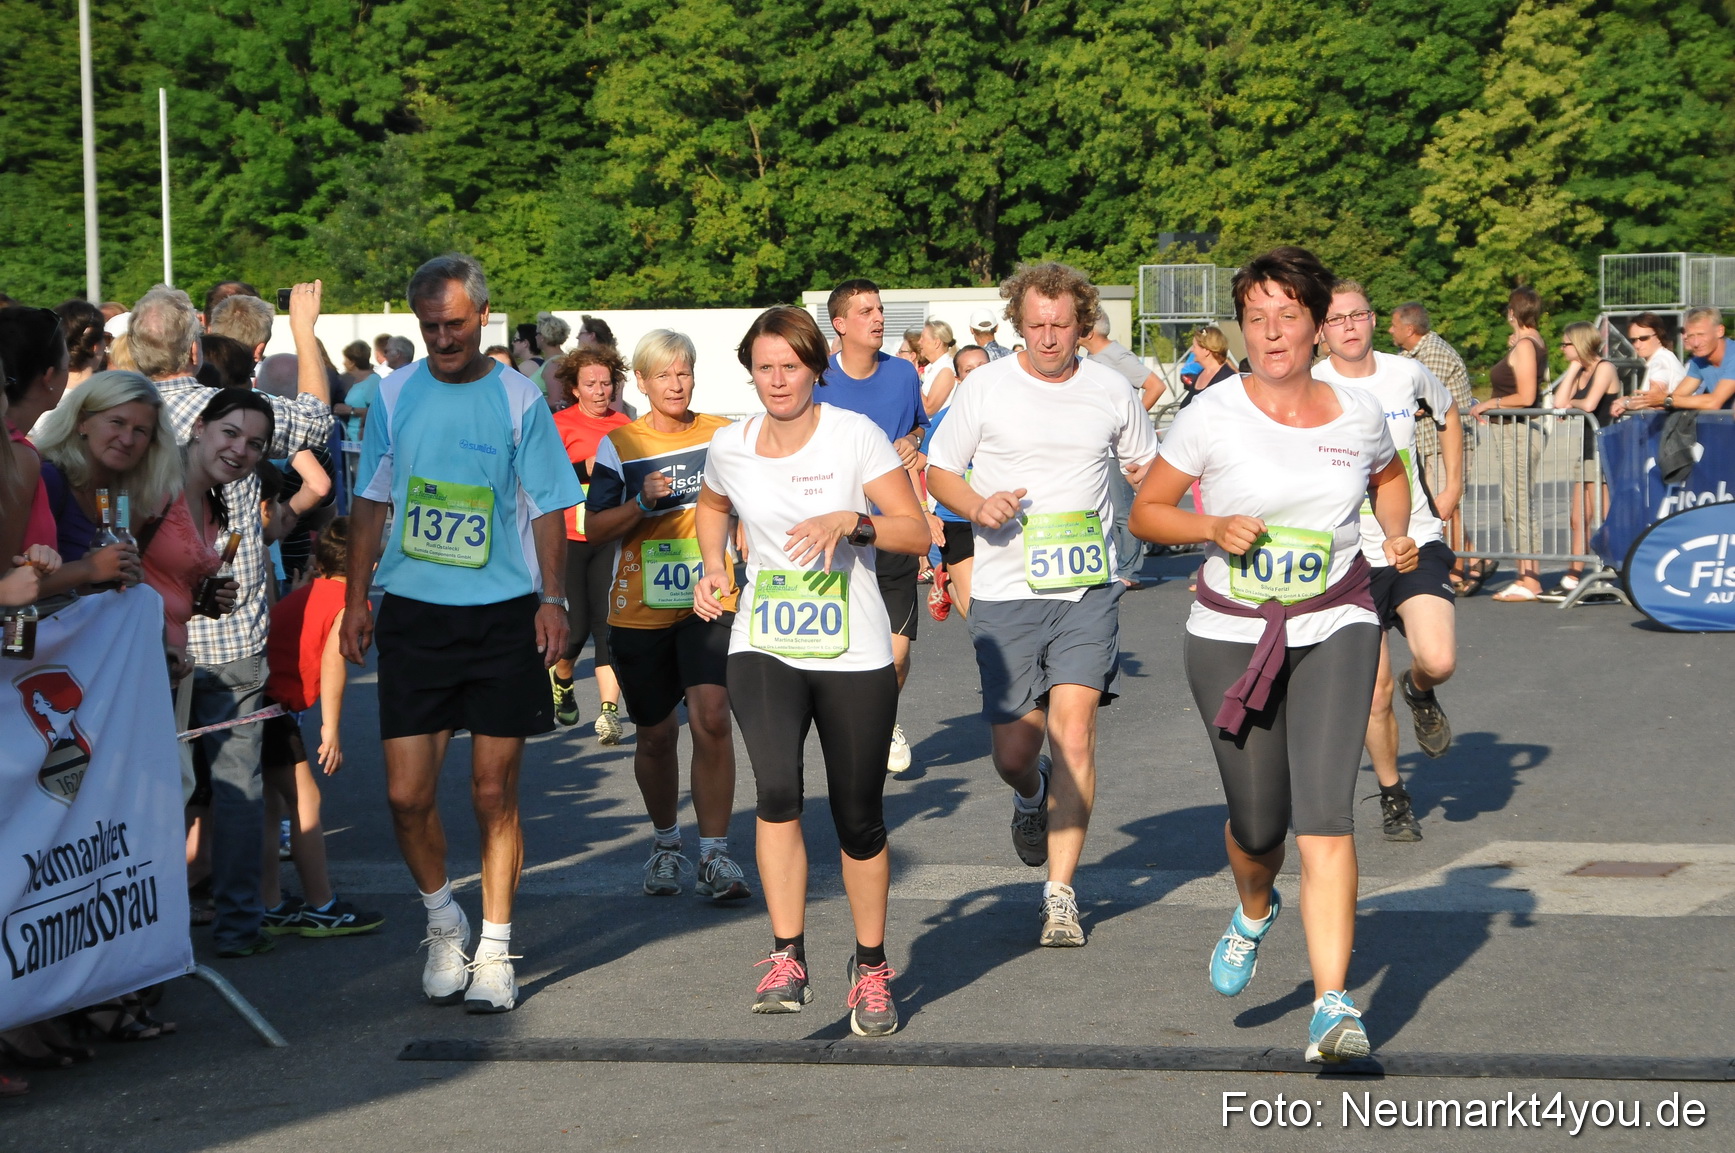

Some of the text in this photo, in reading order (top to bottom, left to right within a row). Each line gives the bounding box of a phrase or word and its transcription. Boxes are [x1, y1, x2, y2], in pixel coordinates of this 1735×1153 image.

[468, 443, 497, 455] sumida
[1318, 446, 1360, 457] Firmenlauf
[1331, 459, 1351, 467] 2014
[668, 471, 704, 490] isch
[791, 472, 834, 483] Firmenlauf
[670, 486, 702, 498] AUTOM
[804, 488, 823, 496] 2014
[407, 506, 486, 547] 1373
[1031, 544, 1103, 578] 5103
[1233, 548, 1323, 584] 1019
[1704, 592, 1735, 604] AU
[755, 601, 842, 636] 1020
[2, 865, 158, 980] Lammsbräu
